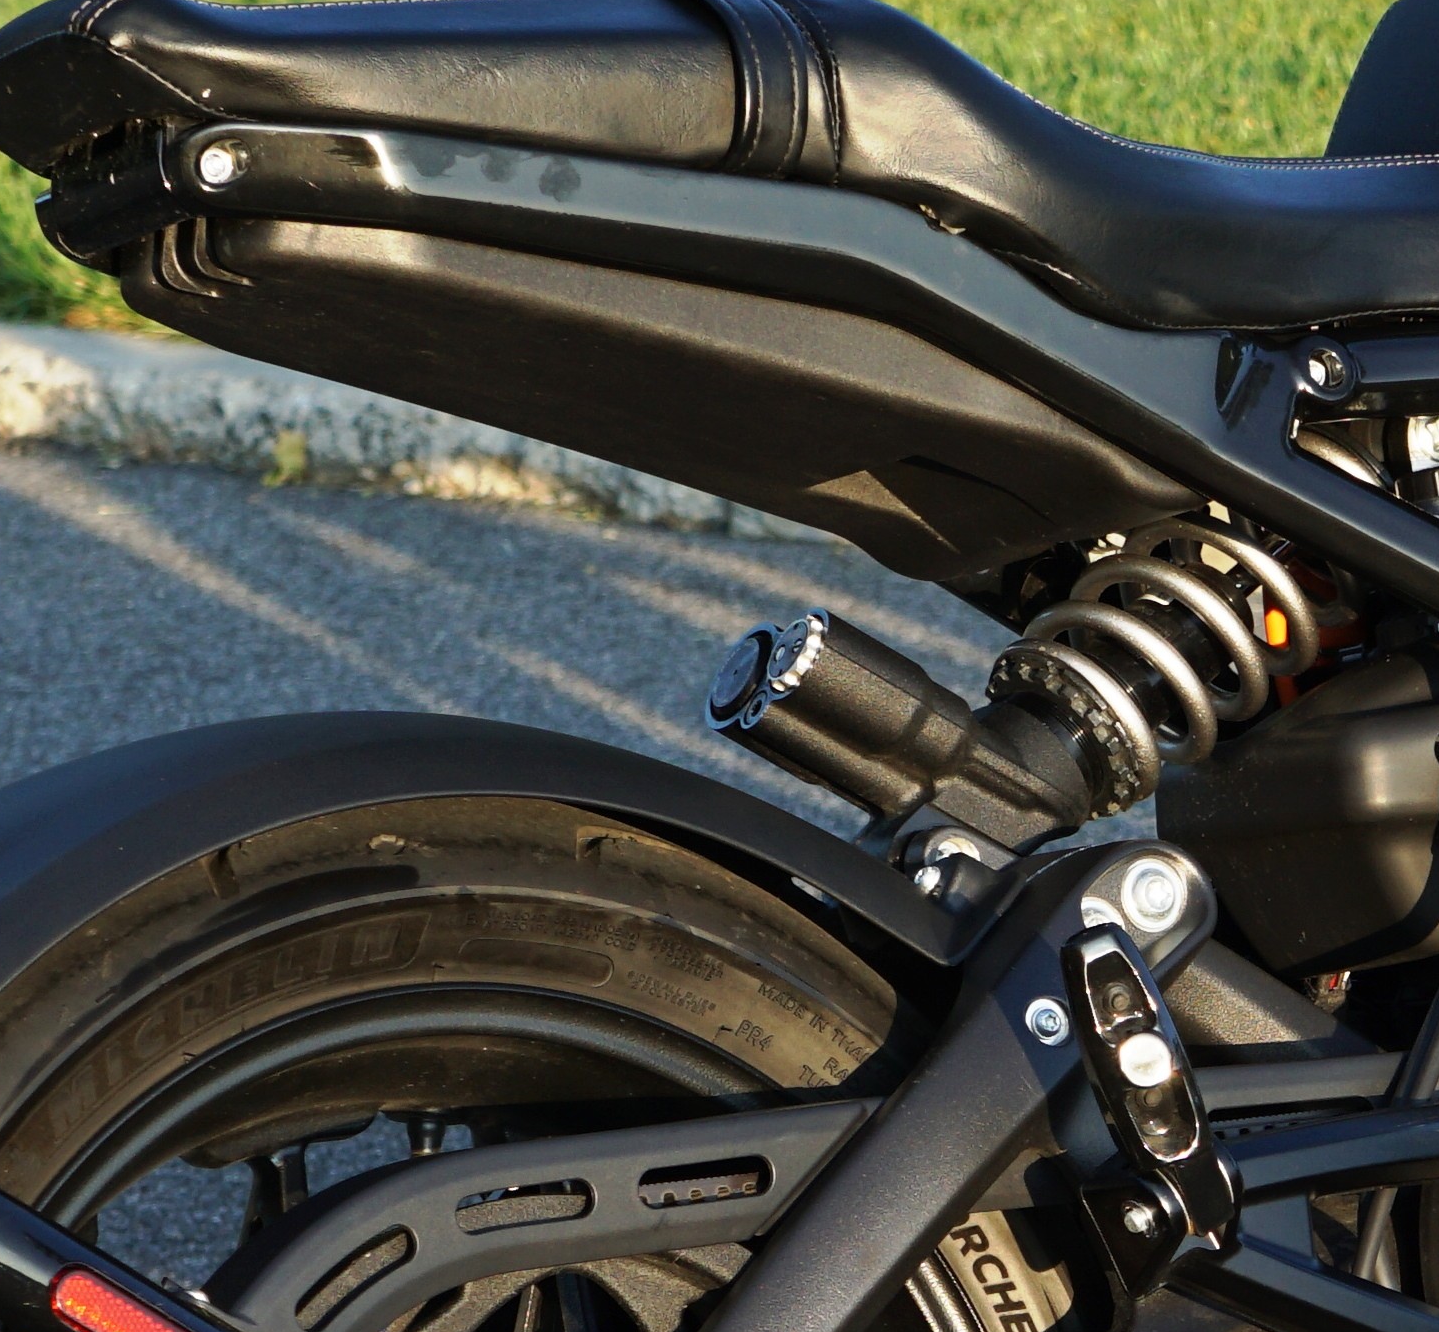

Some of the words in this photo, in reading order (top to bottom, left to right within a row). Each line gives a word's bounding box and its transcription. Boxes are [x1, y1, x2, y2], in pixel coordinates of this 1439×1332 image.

[47, 920, 404, 1136] MICHELIN
[757, 981, 809, 1020] MADE
[809, 1013, 830, 1034] IN
[734, 1019, 775, 1052] PR4
